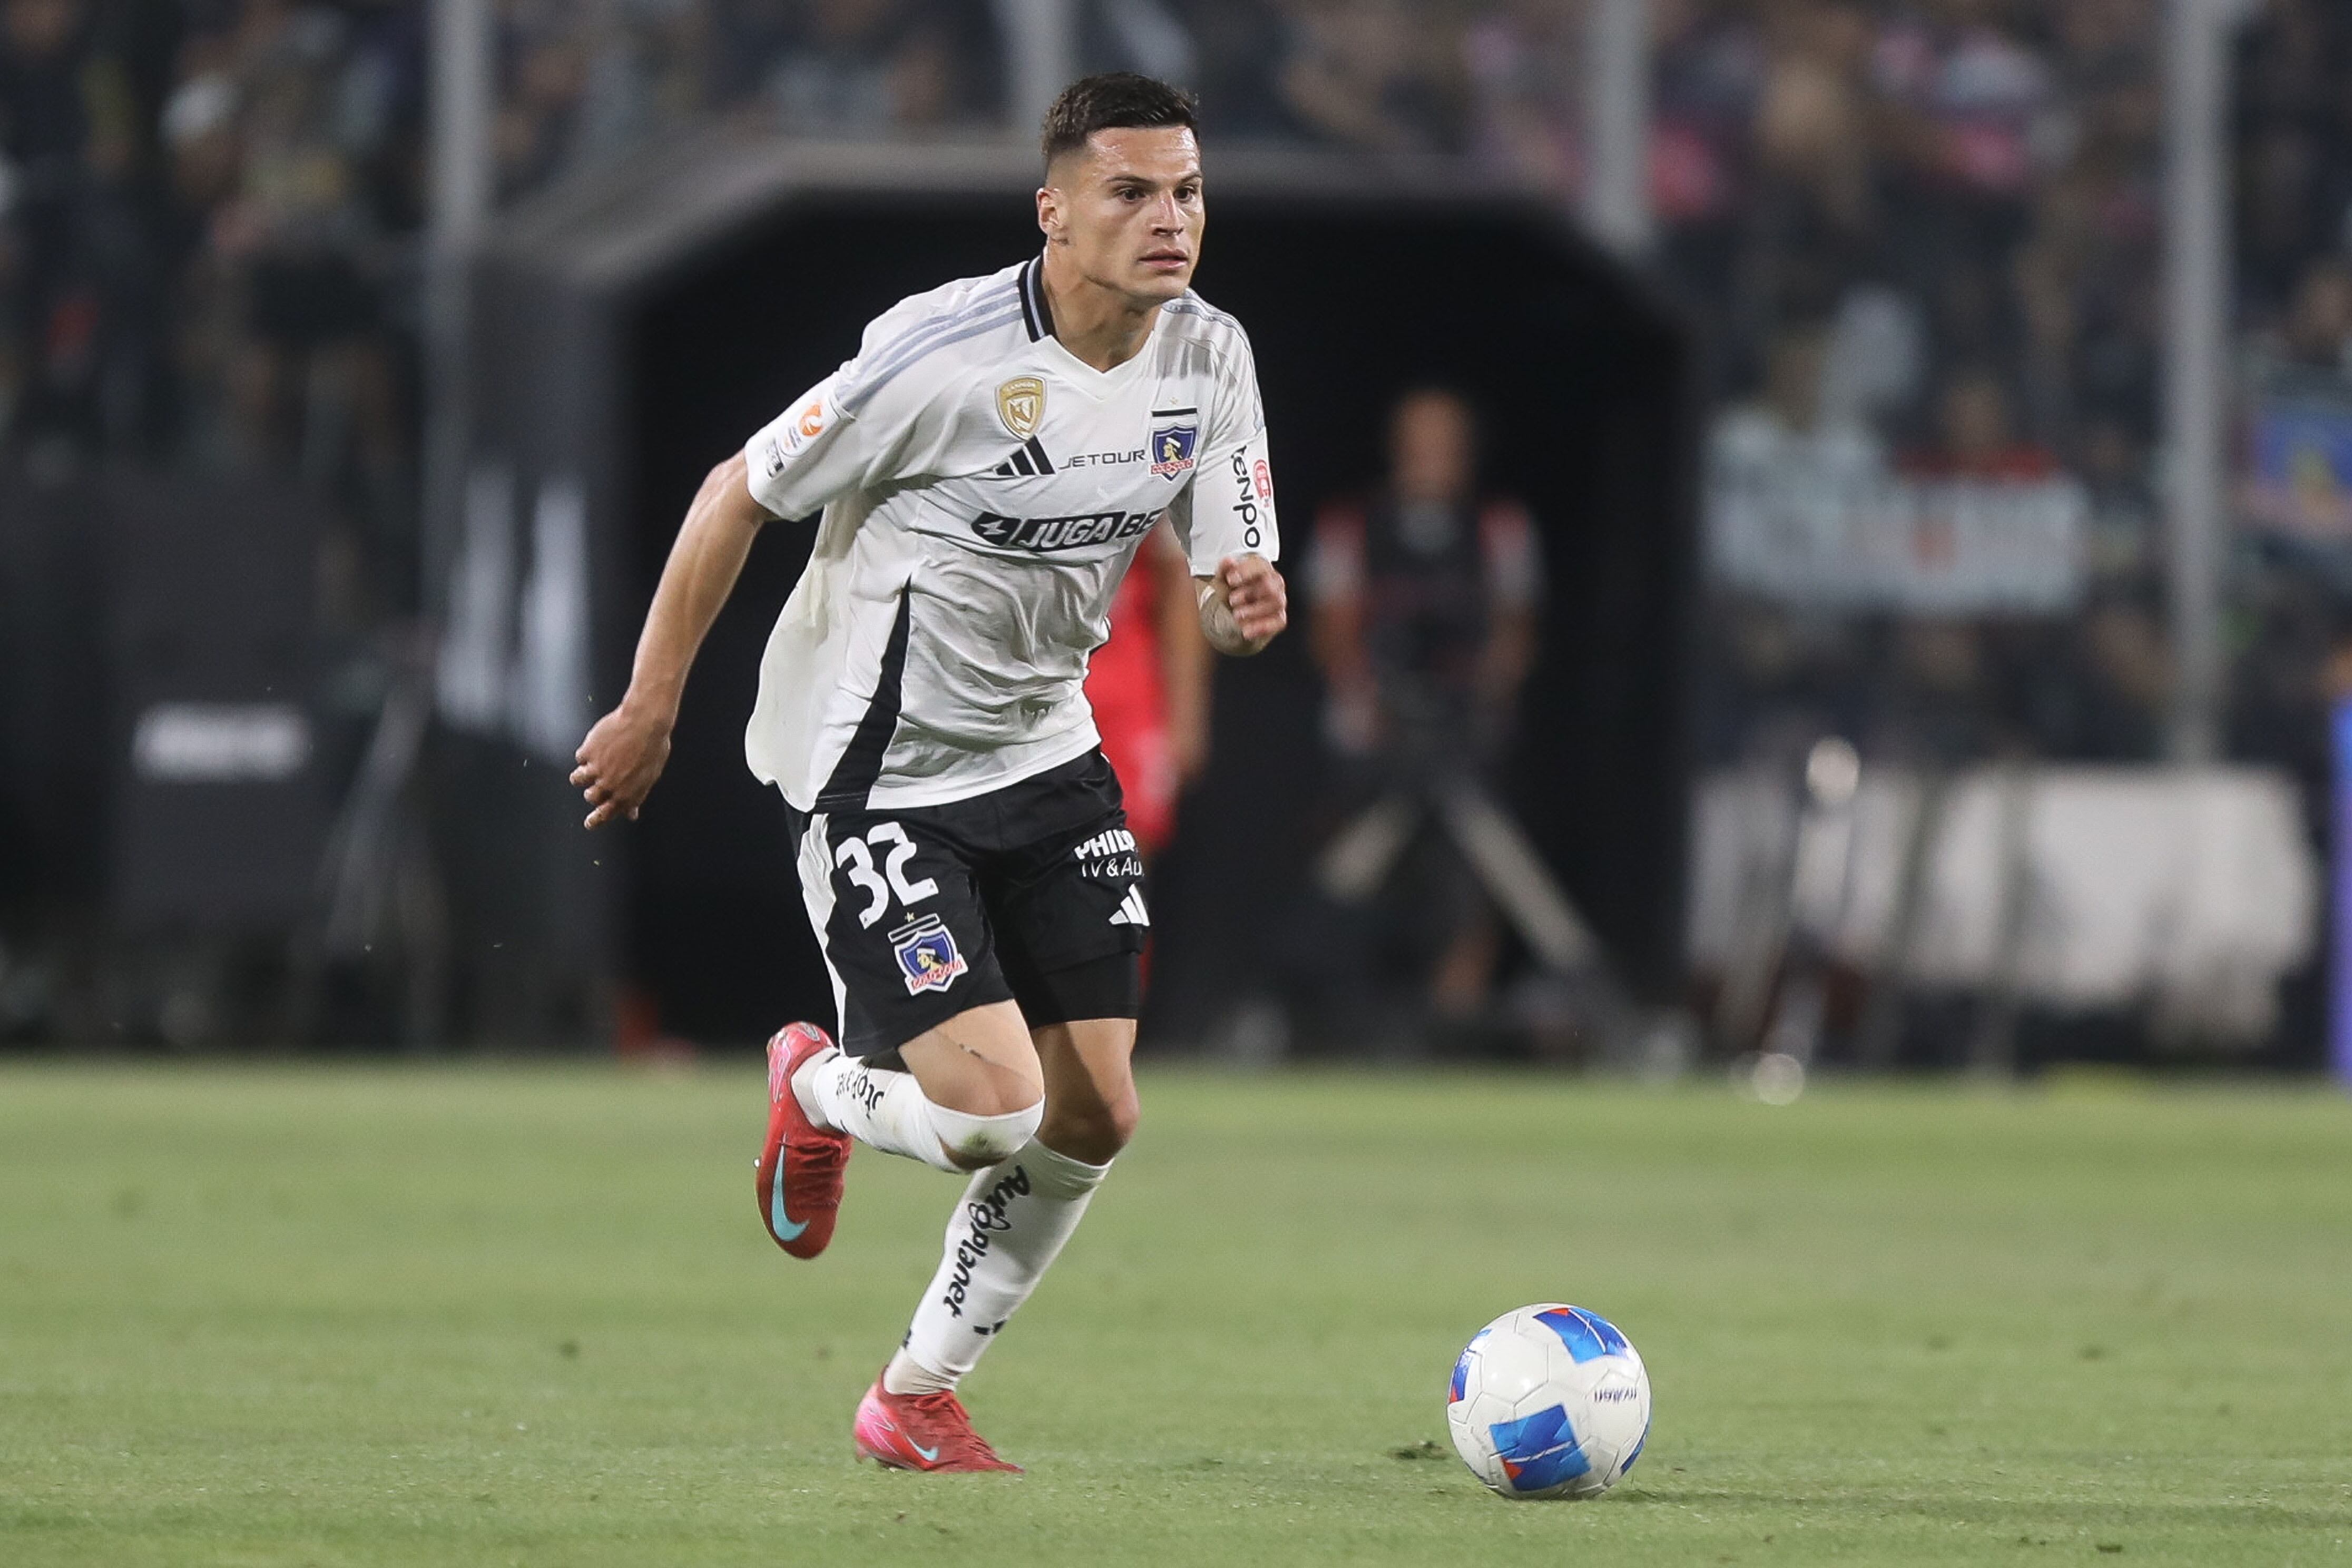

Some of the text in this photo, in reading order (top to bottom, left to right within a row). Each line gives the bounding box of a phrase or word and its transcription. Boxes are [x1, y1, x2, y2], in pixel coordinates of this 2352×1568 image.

[1058, 449, 1146, 470] JETOUR
[1018, 507, 1166, 548] JUGABE
[836, 821, 938, 929] 32
[1107, 858, 1119, 877] &
[1121, 857, 1144, 877] Au
